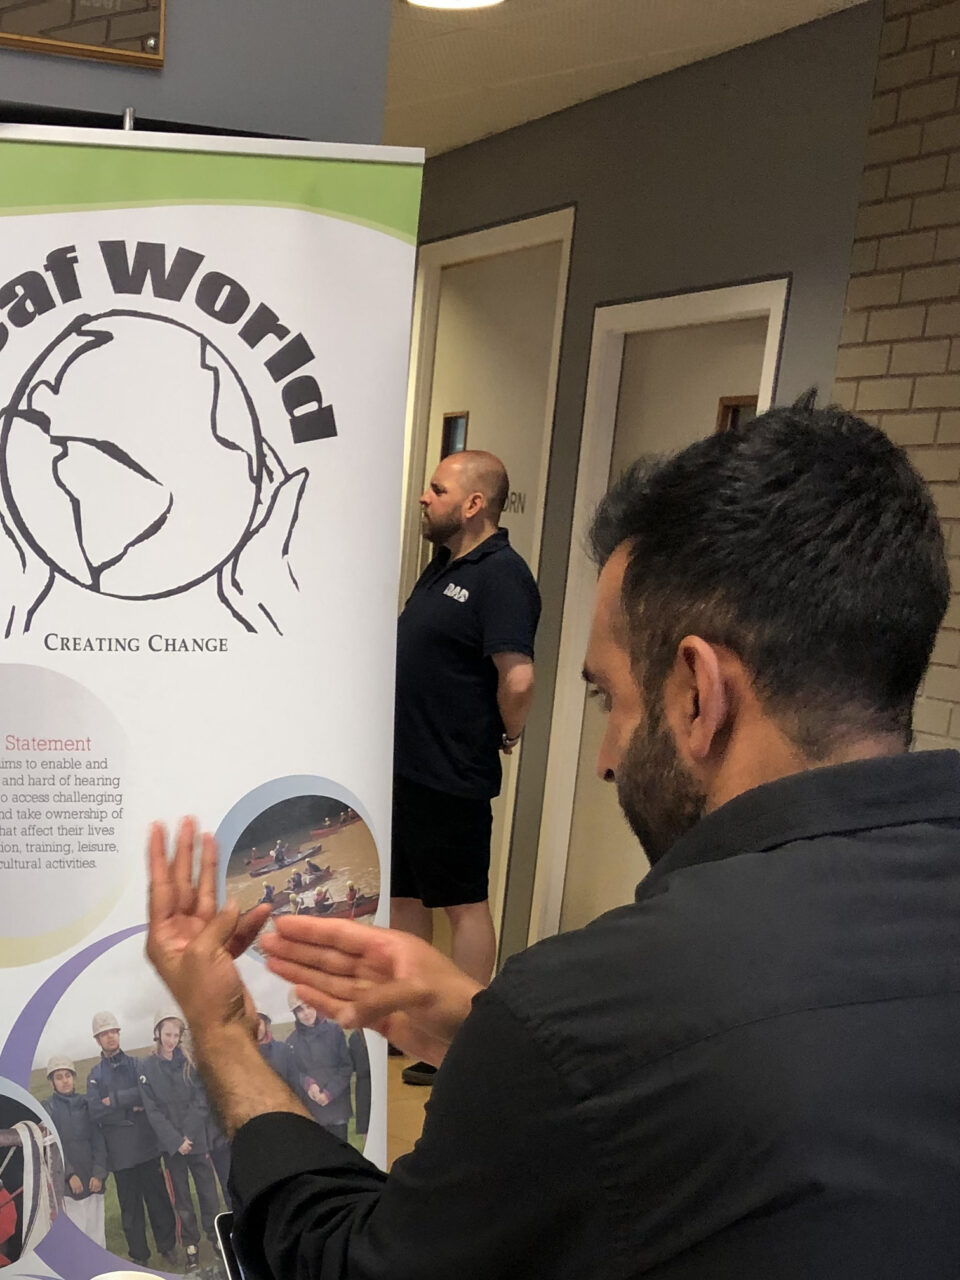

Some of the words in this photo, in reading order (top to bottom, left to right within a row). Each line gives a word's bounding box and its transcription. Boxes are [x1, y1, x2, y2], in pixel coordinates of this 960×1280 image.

[98, 239, 338, 444] World
[43, 632, 142, 654] CREATING
[147, 632, 229, 654] CHANGE
[5, 735, 92, 751] Statement
[26, 759, 37, 769] to
[41, 757, 82, 769] enable
[85, 757, 108, 769] and
[2, 774, 24, 786] and
[28, 774, 55, 786] hard
[59, 774, 71, 786] of
[74, 774, 120, 789] hearing
[12, 793, 49, 803] access
[53, 791, 123, 806] challenging
[16, 809, 42, 820] take
[45, 809, 108, 823] ownership
[111, 808, 123, 819] of
[21, 825, 53, 836] affect
[57, 825, 84, 836] their
[87, 825, 114, 836] lives
